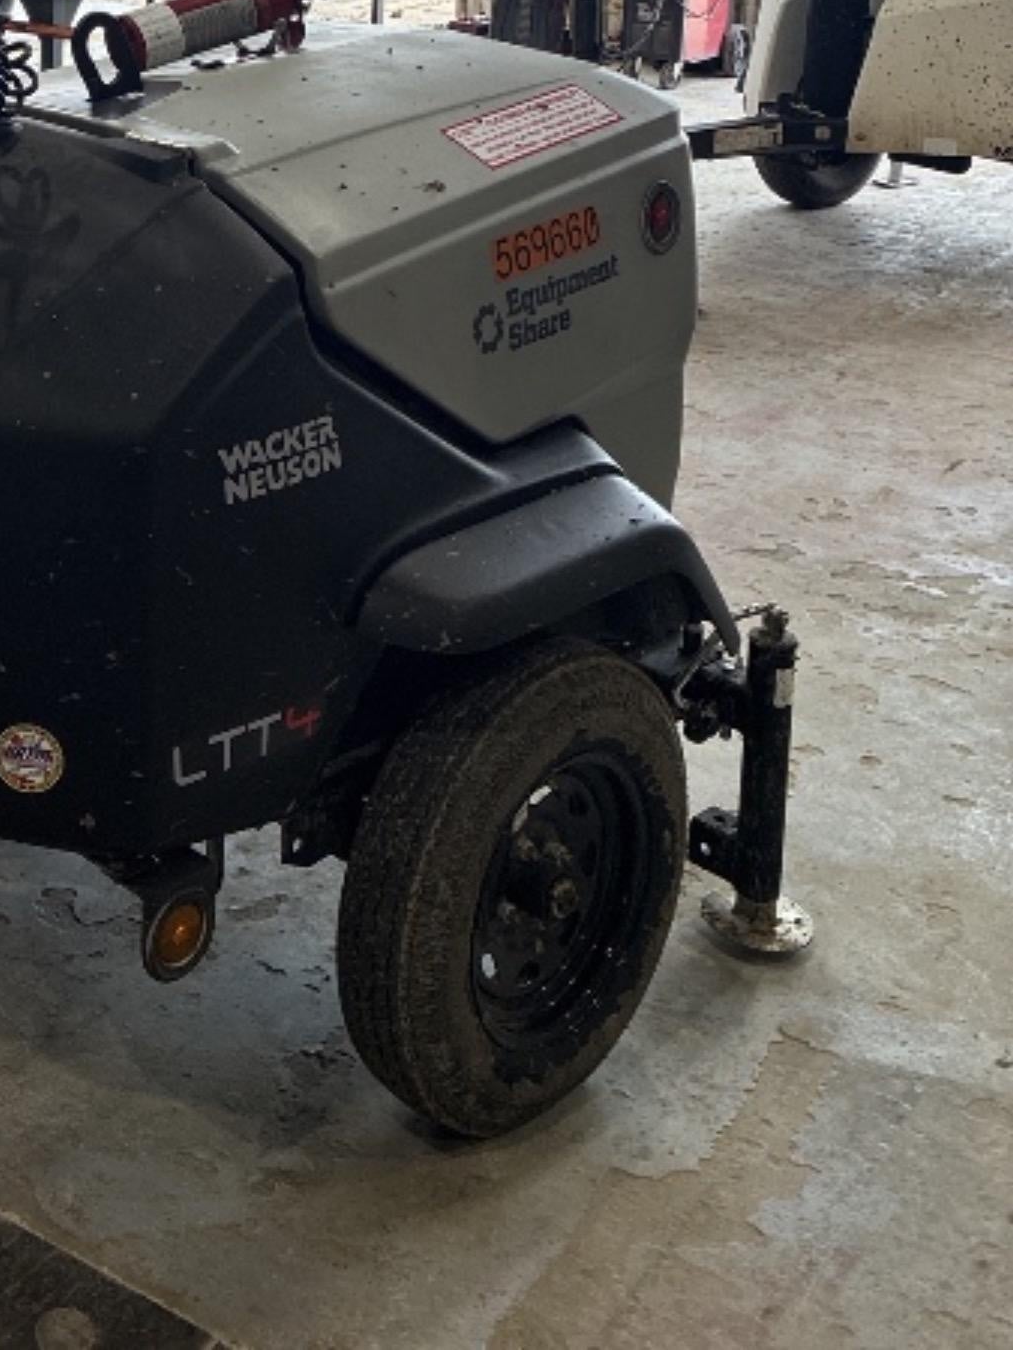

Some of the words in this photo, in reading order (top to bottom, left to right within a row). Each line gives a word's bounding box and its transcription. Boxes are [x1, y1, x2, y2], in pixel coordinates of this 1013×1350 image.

[495, 205, 600, 280] 569660
[505, 254, 620, 318] Equipment
[508, 308, 572, 351] Share
[217, 415, 340, 474] WACKER
[223, 440, 342, 505] NEUSON
[172, 708, 321, 787] LTT4
